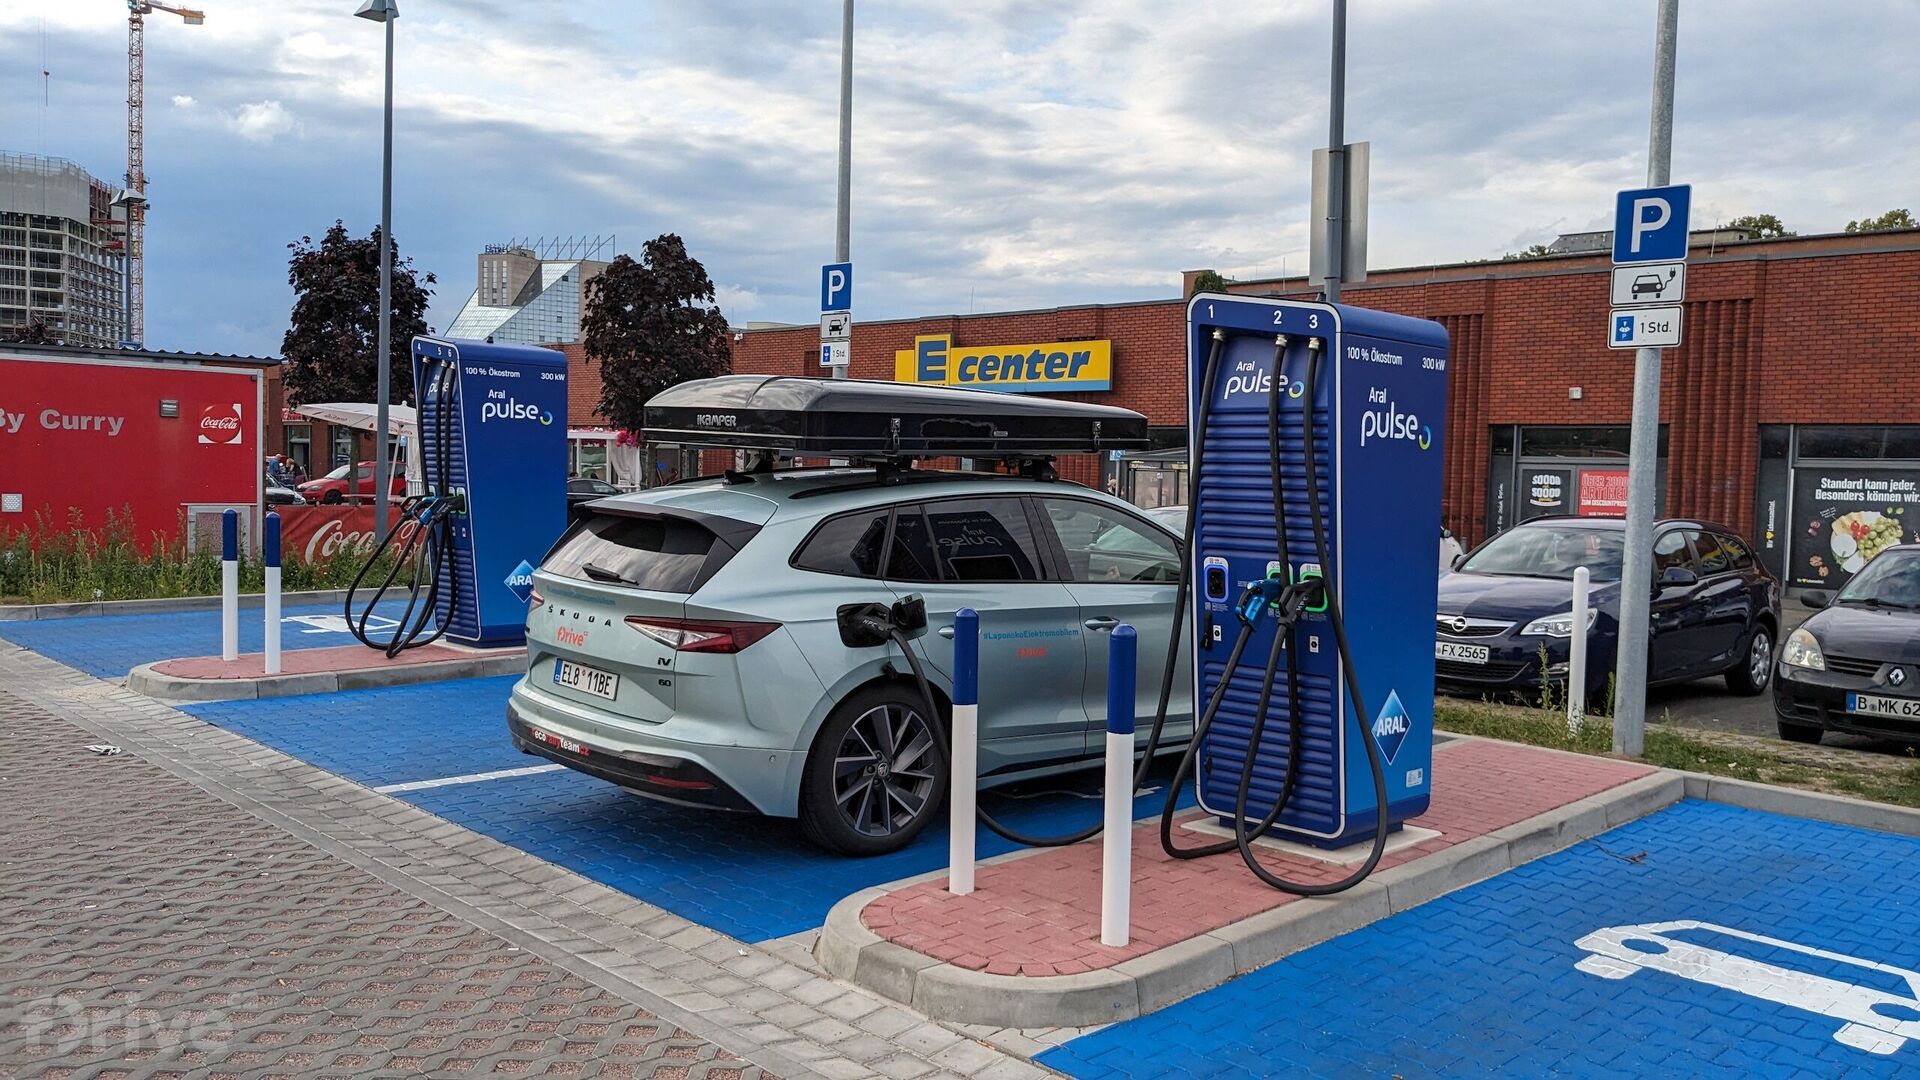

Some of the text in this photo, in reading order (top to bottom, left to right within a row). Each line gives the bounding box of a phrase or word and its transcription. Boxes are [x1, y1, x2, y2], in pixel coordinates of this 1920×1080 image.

[1630, 197, 1671, 253] P
[827, 269, 845, 306] P
[1208, 304, 1318, 329] 1 2 3
[1640, 321, 1672, 334] 1 Std.
[918, 340, 1092, 382] E center
[1346, 346, 1360, 360] 100
[1370, 346, 1403, 366] Ökostrom
[1421, 357, 1446, 371] 300 kW
[465, 366, 478, 376] 100
[488, 366, 521, 379] Ökostrom
[1235, 360, 1256, 372] Aral
[540, 372, 566, 382] 300 kW
[1224, 368, 1289, 400] pulse
[488, 389, 506, 399] Aral
[1368, 387, 1387, 404] Aral
[482, 398, 539, 423] pulse
[39, 408, 125, 437] Curry
[1360, 402, 1418, 447] pulse
[1820, 477, 1916, 493] Standard kann jeder.
[1815, 488, 1920, 503] Besonders können wir.
[509, 575, 533, 587] ARA
[1441, 644, 1487, 660] FX 2565
[561, 663, 612, 696] EL8 11BE
[1857, 696, 1867, 710] B
[1878, 699, 1898, 714] MK
[1375, 716, 1406, 738] ARAL
